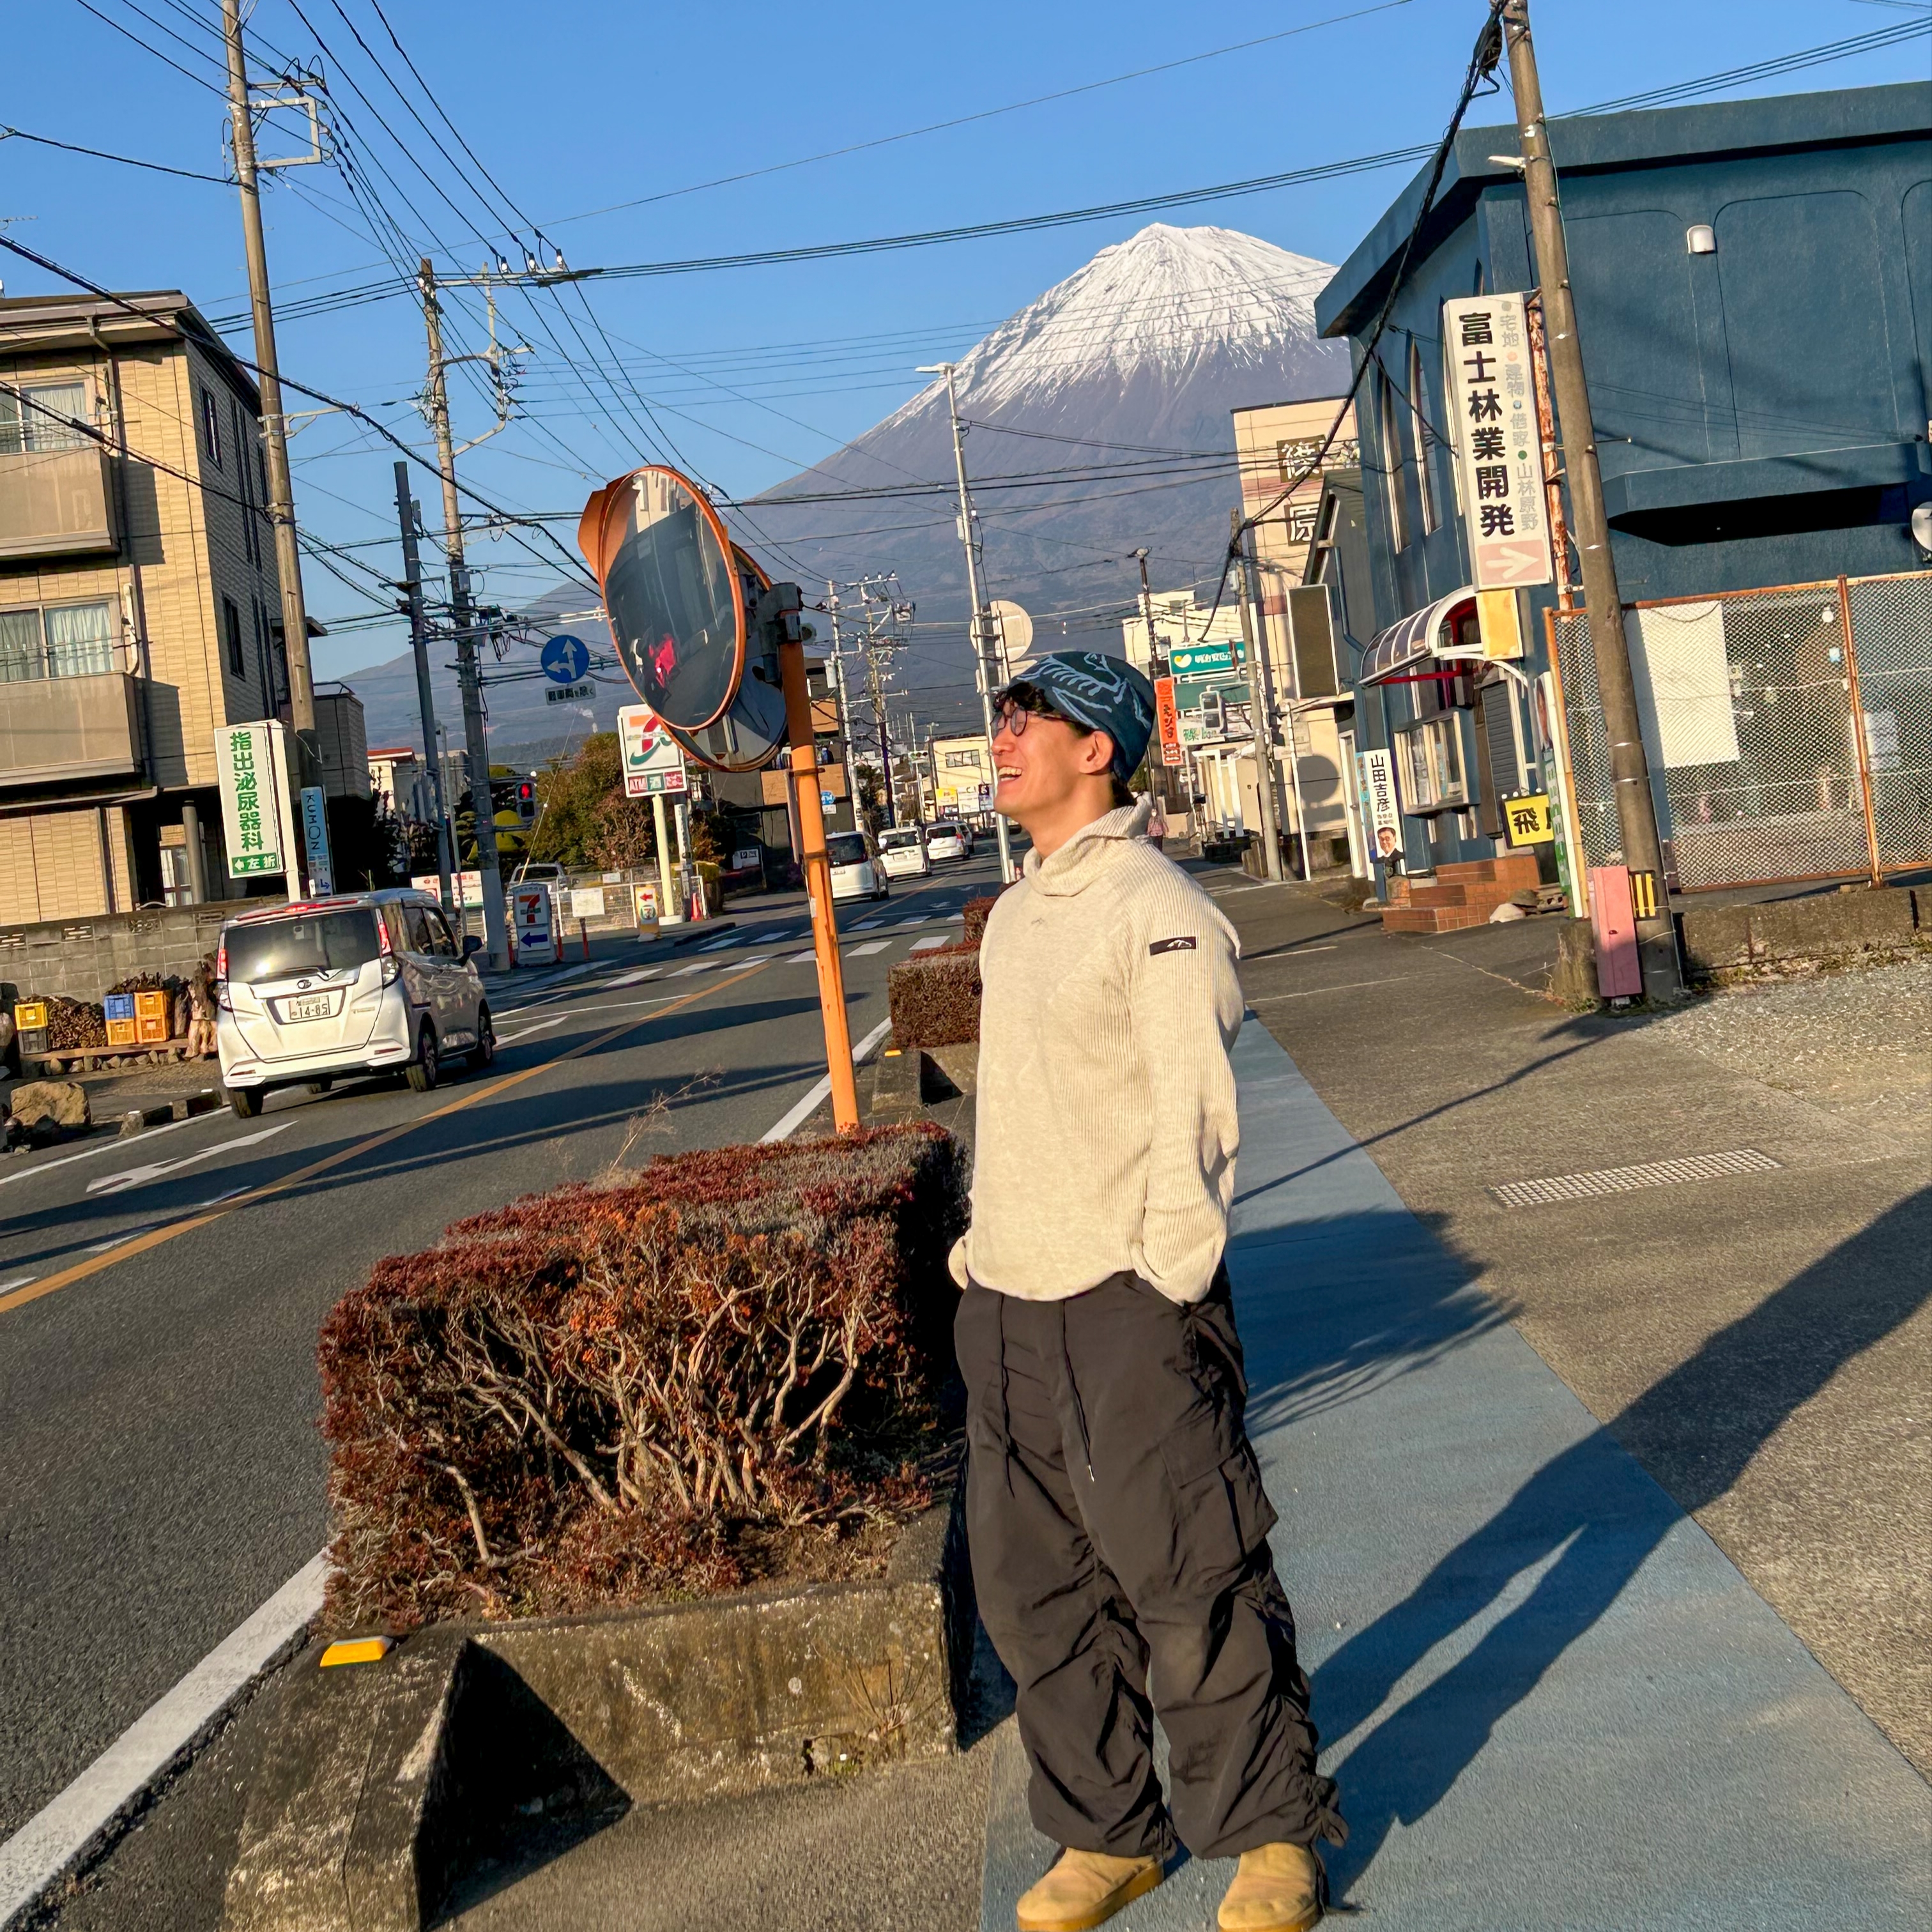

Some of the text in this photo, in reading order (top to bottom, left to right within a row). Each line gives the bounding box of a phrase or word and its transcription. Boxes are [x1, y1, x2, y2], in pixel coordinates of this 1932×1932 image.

[1459, 312, 1515, 537] 富士林業開発
[1517, 463, 1538, 531] 山林原野
[230, 731, 264, 852] 指出泌尿器科
[1370, 754, 1390, 812] 山田吉彦
[305, 794, 321, 850] KUMON
[1511, 807, 1551, 835] 飛
[247, 855, 276, 870] 左折
